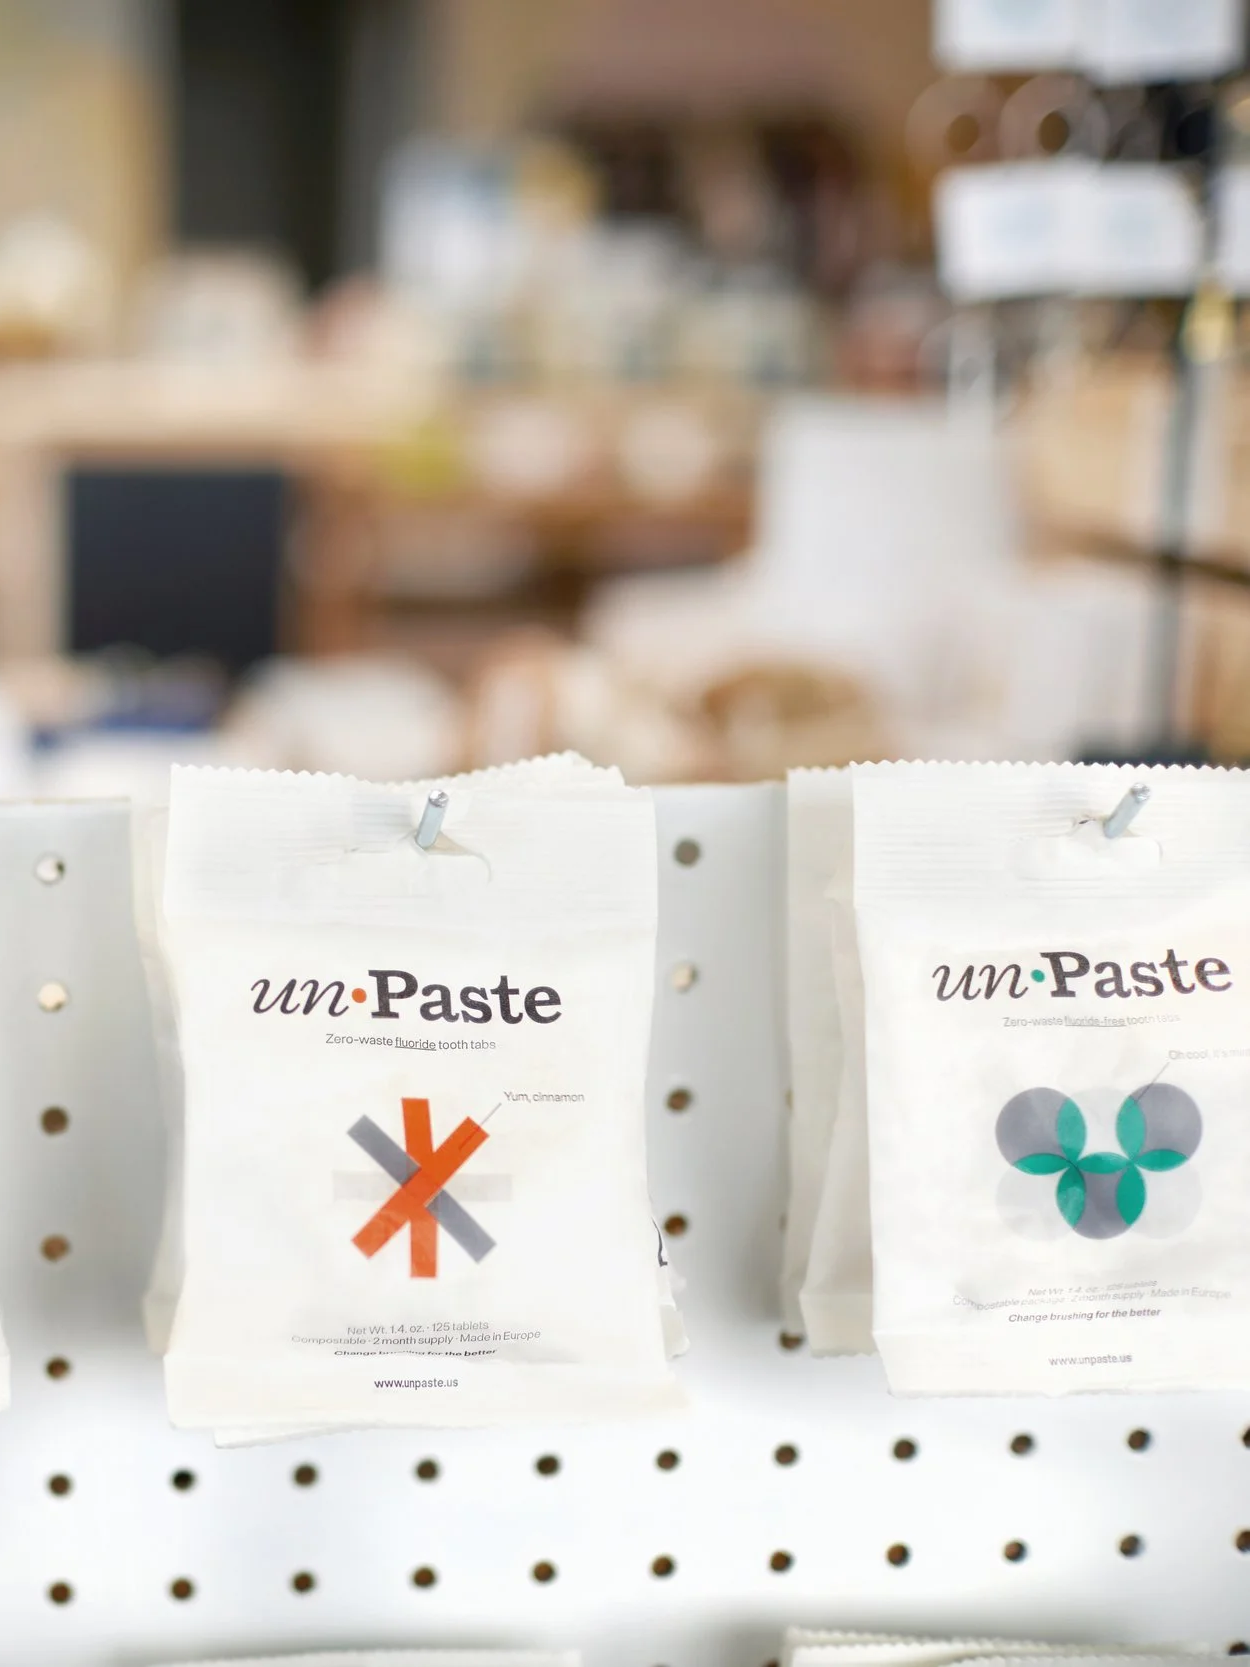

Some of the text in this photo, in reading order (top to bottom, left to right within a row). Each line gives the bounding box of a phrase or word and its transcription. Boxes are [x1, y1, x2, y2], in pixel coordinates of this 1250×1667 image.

[1002, 1016, 1063, 1027] Zero-waste
[1064, 1015, 1127, 1028] fluoride-free
[325, 1033, 496, 1051] Zero-waste fluoride tooth tabs
[504, 1091, 586, 1104] Yum, cinnamon
[1008, 1307, 1161, 1323] Change brushing for the better
[346, 1325, 367, 1336] Net
[368, 1324, 388, 1335] Wt.
[432, 1322, 451, 1332] 125
[451, 1320, 490, 1331] tablets
[290, 1330, 541, 1346] Compostable 2 month supply Made in Europe
[1048, 1353, 1132, 1366] www.unpaste.us
[373, 1378, 459, 1391] www.unpaste.us
